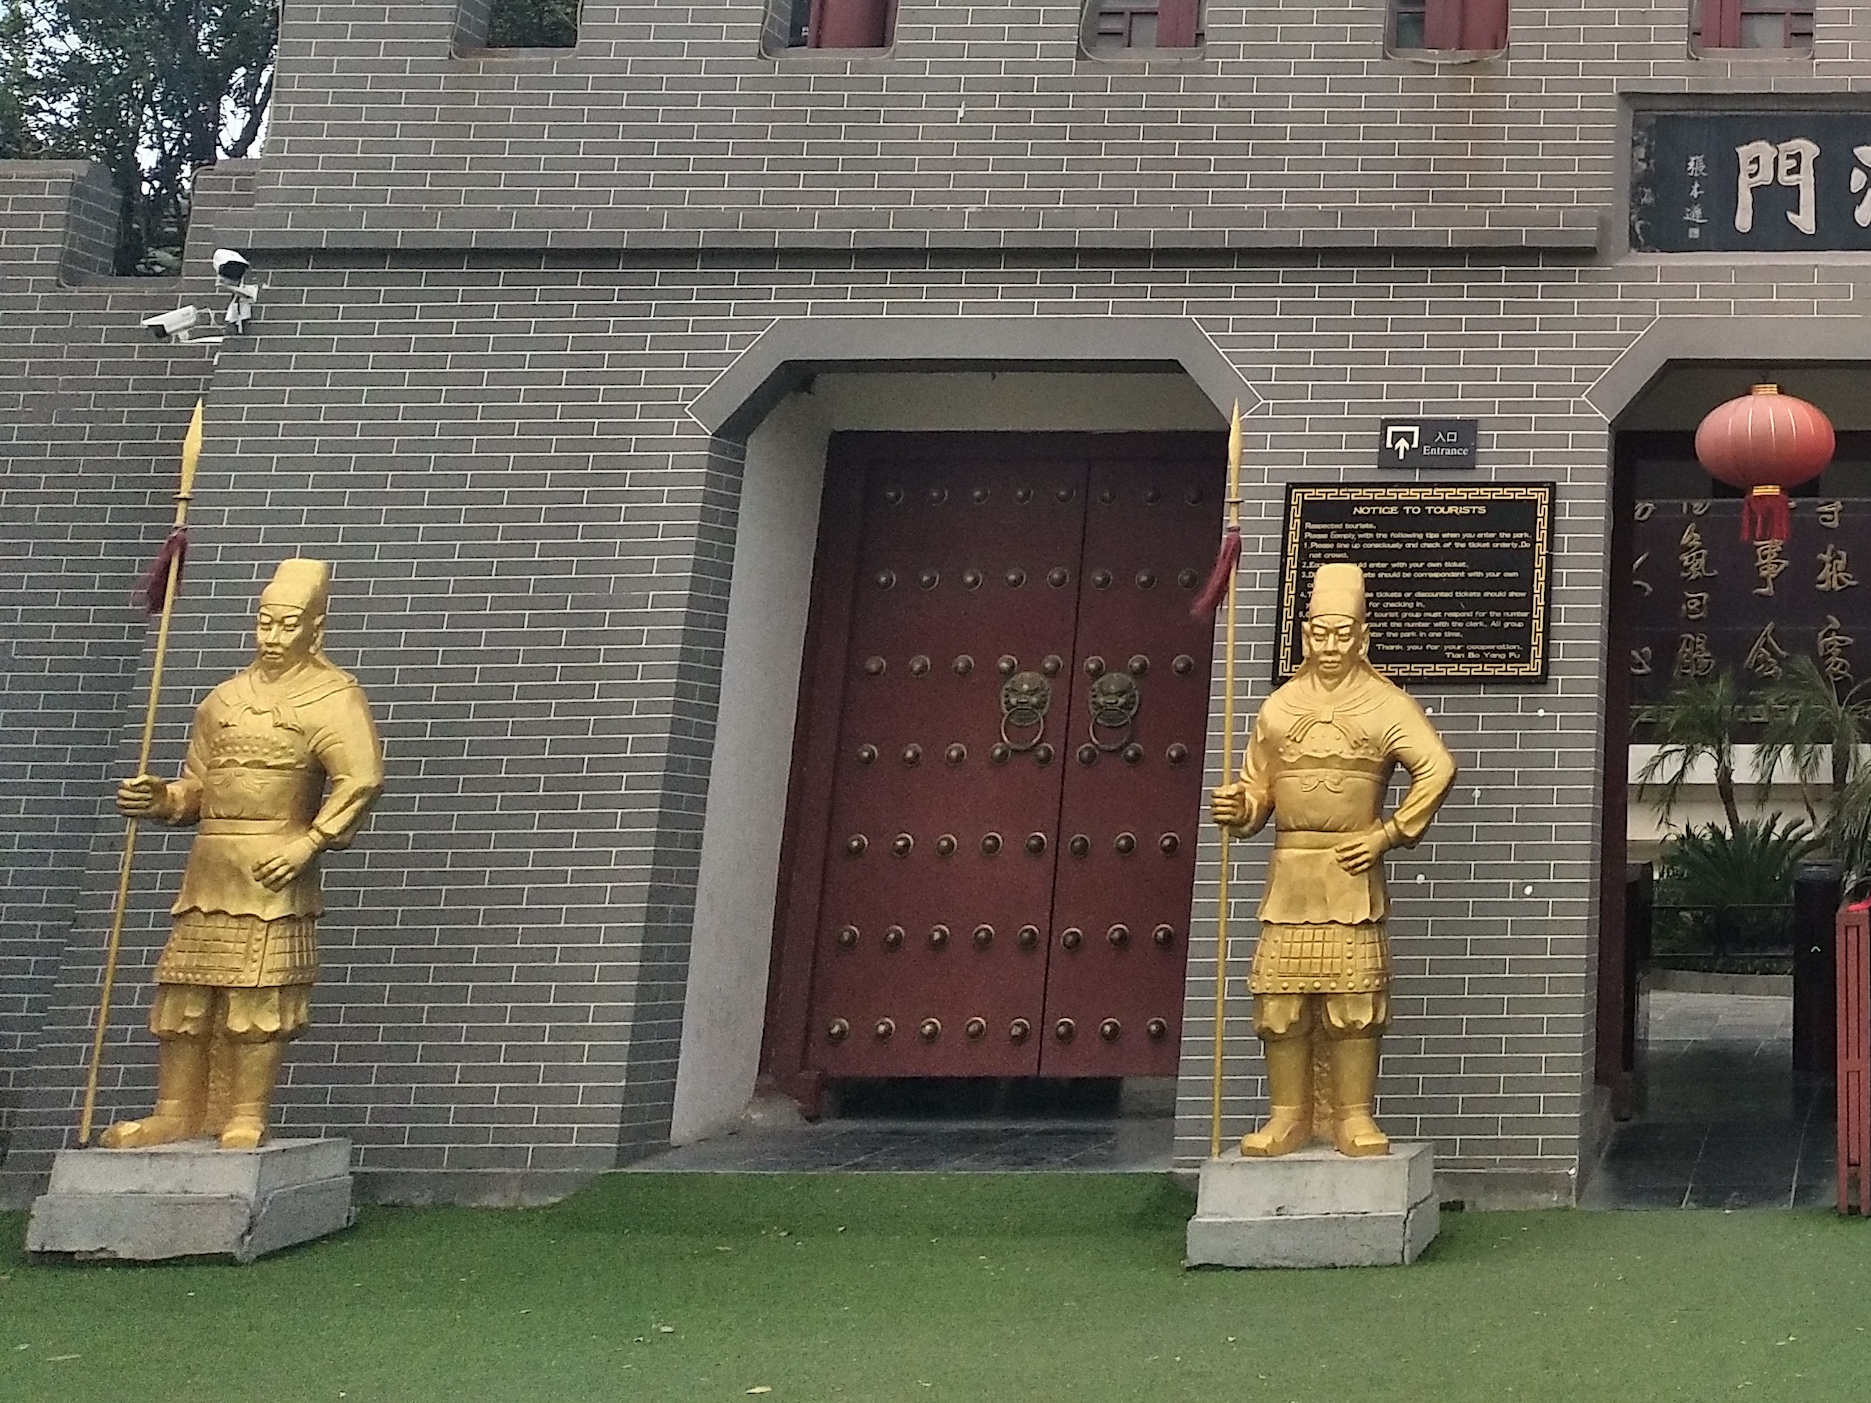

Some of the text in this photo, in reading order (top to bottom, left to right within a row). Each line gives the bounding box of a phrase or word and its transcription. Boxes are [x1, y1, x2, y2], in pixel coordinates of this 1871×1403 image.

[1433, 430, 1458, 443] 入口
[1422, 445, 1469, 457] Entrance
[1352, 505, 1487, 516] NOTICE TO TOURISTS
[1304, 521, 1344, 530] Respected
[1304, 531, 1329, 539] Please
[1389, 532, 1424, 540] following
[1461, 532, 1476, 540] you
[1498, 531, 1512, 539] the
[1362, 542, 1404, 550] consciously
[1419, 541, 1441, 549] check
[1453, 541, 1467, 549] the
[1485, 571, 1502, 579] your
[1382, 601, 1415, 609] checking
[1503, 621, 1525, 629] group
[1375, 643, 1403, 651] Thank
[1443, 644, 1464, 652] your
[1467, 651, 1481, 659] Bo
[1483, 651, 1507, 660] Yang
[1508, 651, 1521, 659] Fu
